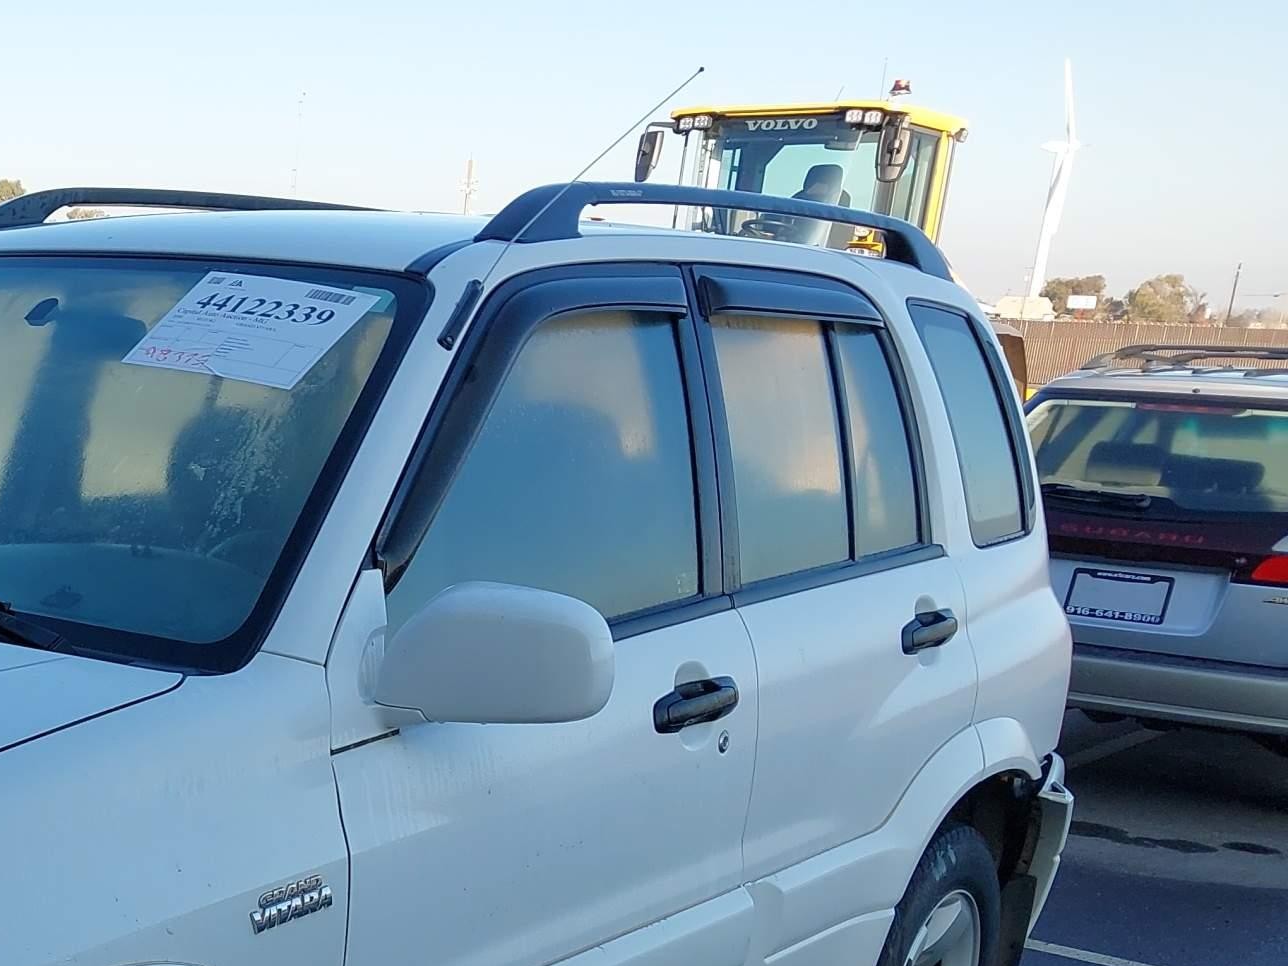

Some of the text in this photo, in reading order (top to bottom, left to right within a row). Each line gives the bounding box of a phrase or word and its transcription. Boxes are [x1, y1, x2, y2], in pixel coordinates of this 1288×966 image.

[745, 118, 818, 131] VOLVO
[196, 292, 336, 326] 44122339
[1061, 523, 1206, 544] SUBARU
[1066, 605, 1162, 624] 916-641-8900
[258, 874, 323, 909] GRAND
[249, 884, 333, 935] VITARA
